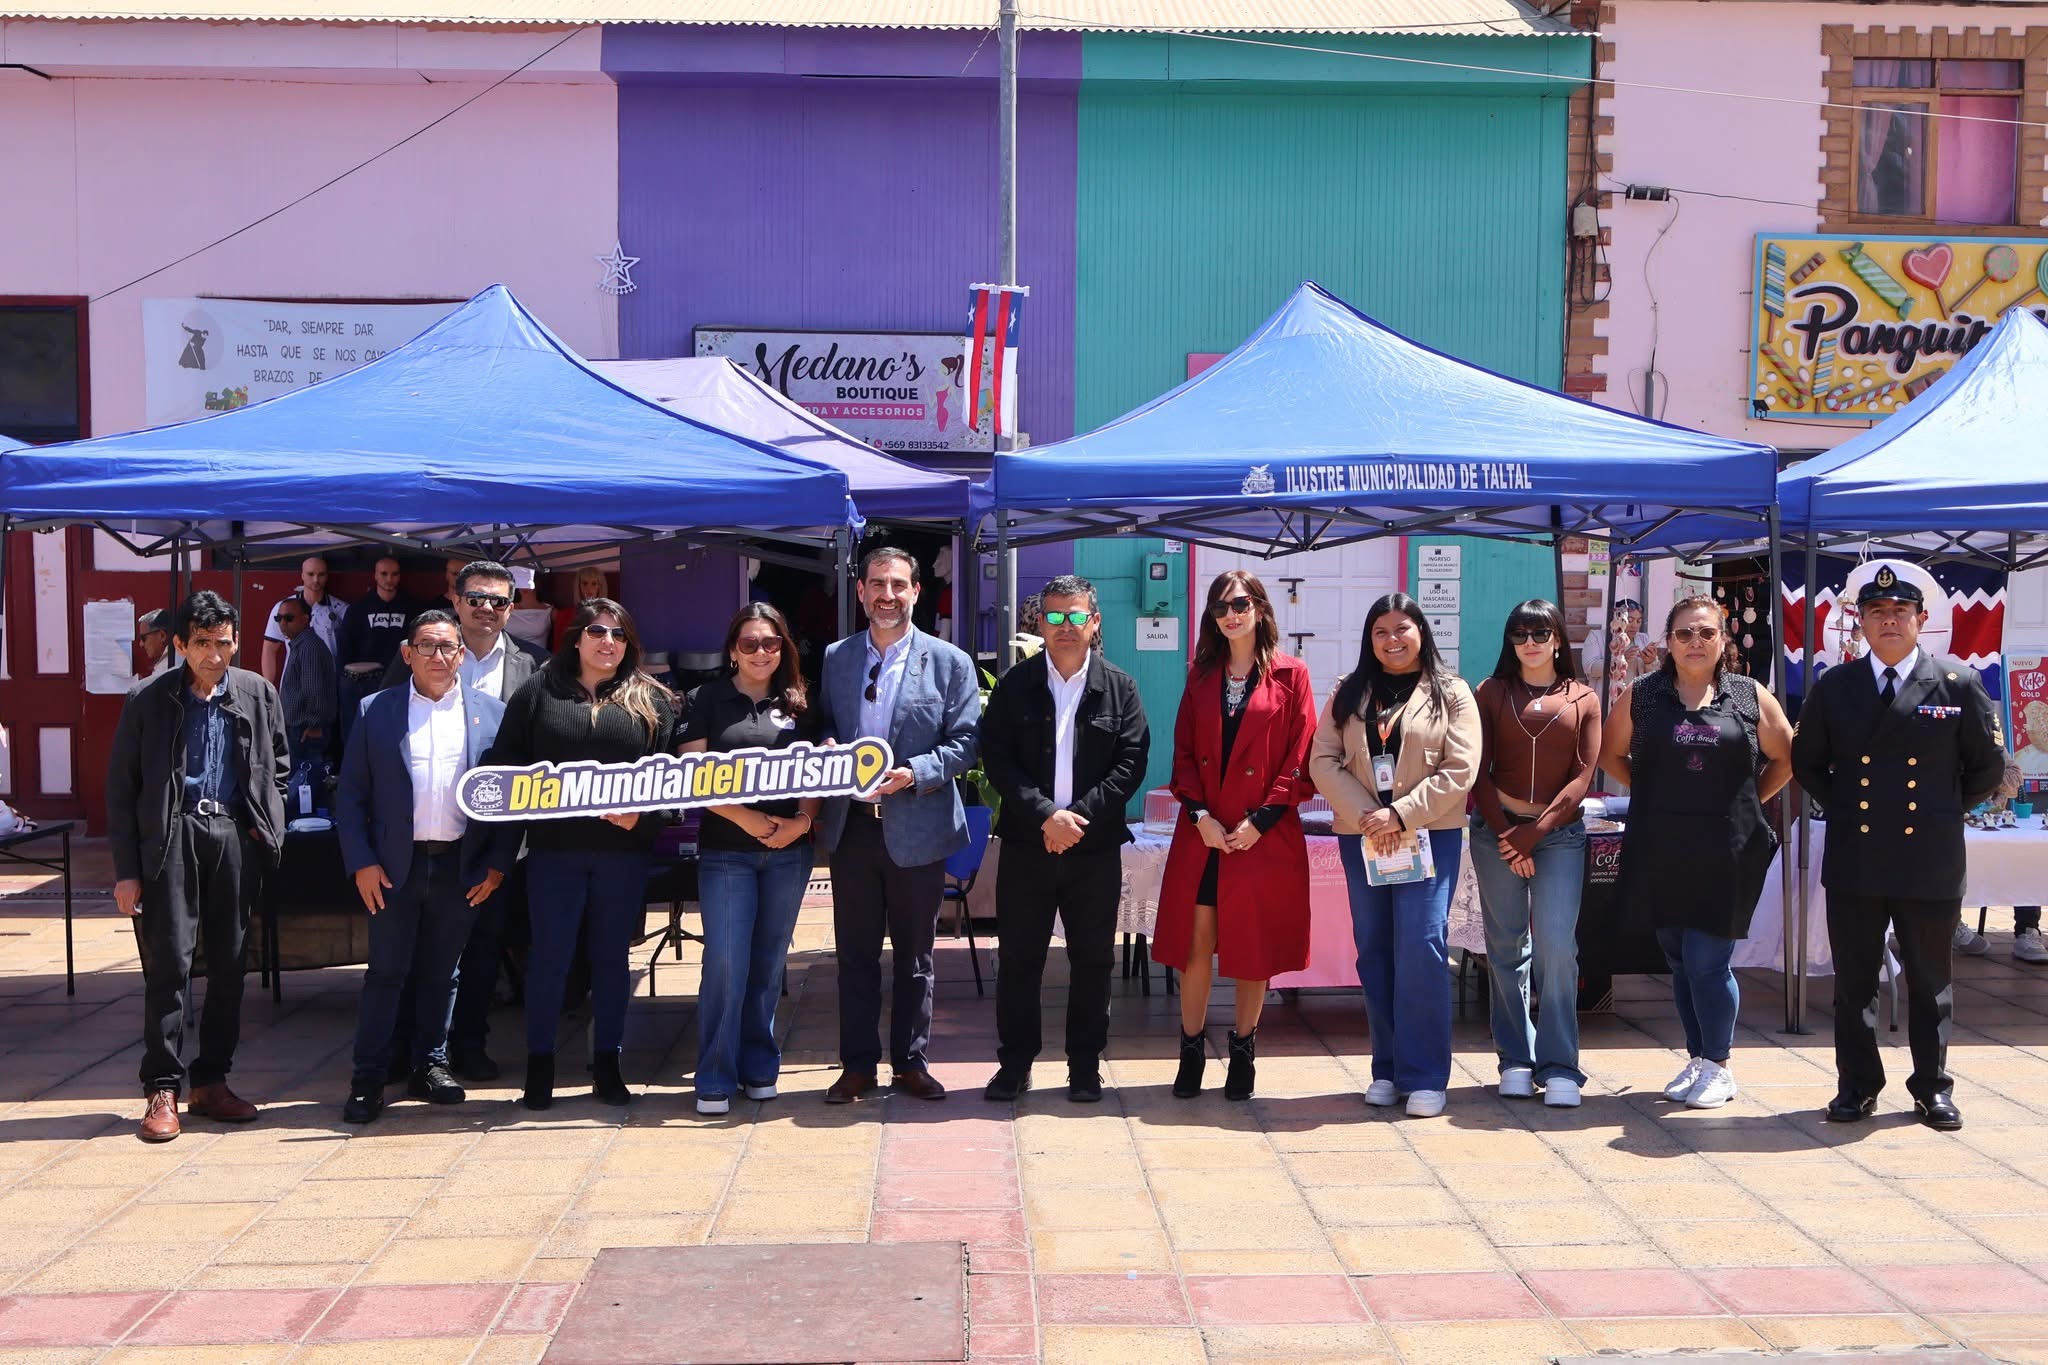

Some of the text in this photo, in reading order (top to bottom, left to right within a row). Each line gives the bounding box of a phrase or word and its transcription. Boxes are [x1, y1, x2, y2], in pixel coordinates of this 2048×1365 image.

[301, 321, 344, 335] SIEMPRE
[354, 323, 374, 336] DAR
[236, 344, 268, 358] HASTA
[280, 346, 302, 359] QUE
[312, 348, 326, 361] SE
[335, 349, 356, 362] NOS
[253, 369, 294, 384] BRAZOS
[752, 342, 926, 401] Medano's
[836, 386, 919, 401] BOUTIQUE
[831, 406, 839, 415] Y
[843, 406, 924, 417] ACCESORIOS
[883, 439, 950, 451] +569 83133542
[1285, 463, 1533, 493] ILUSTRE MUNICIPALIDAD DE TALTAL
[2020, 671, 2046, 690] KitKat
